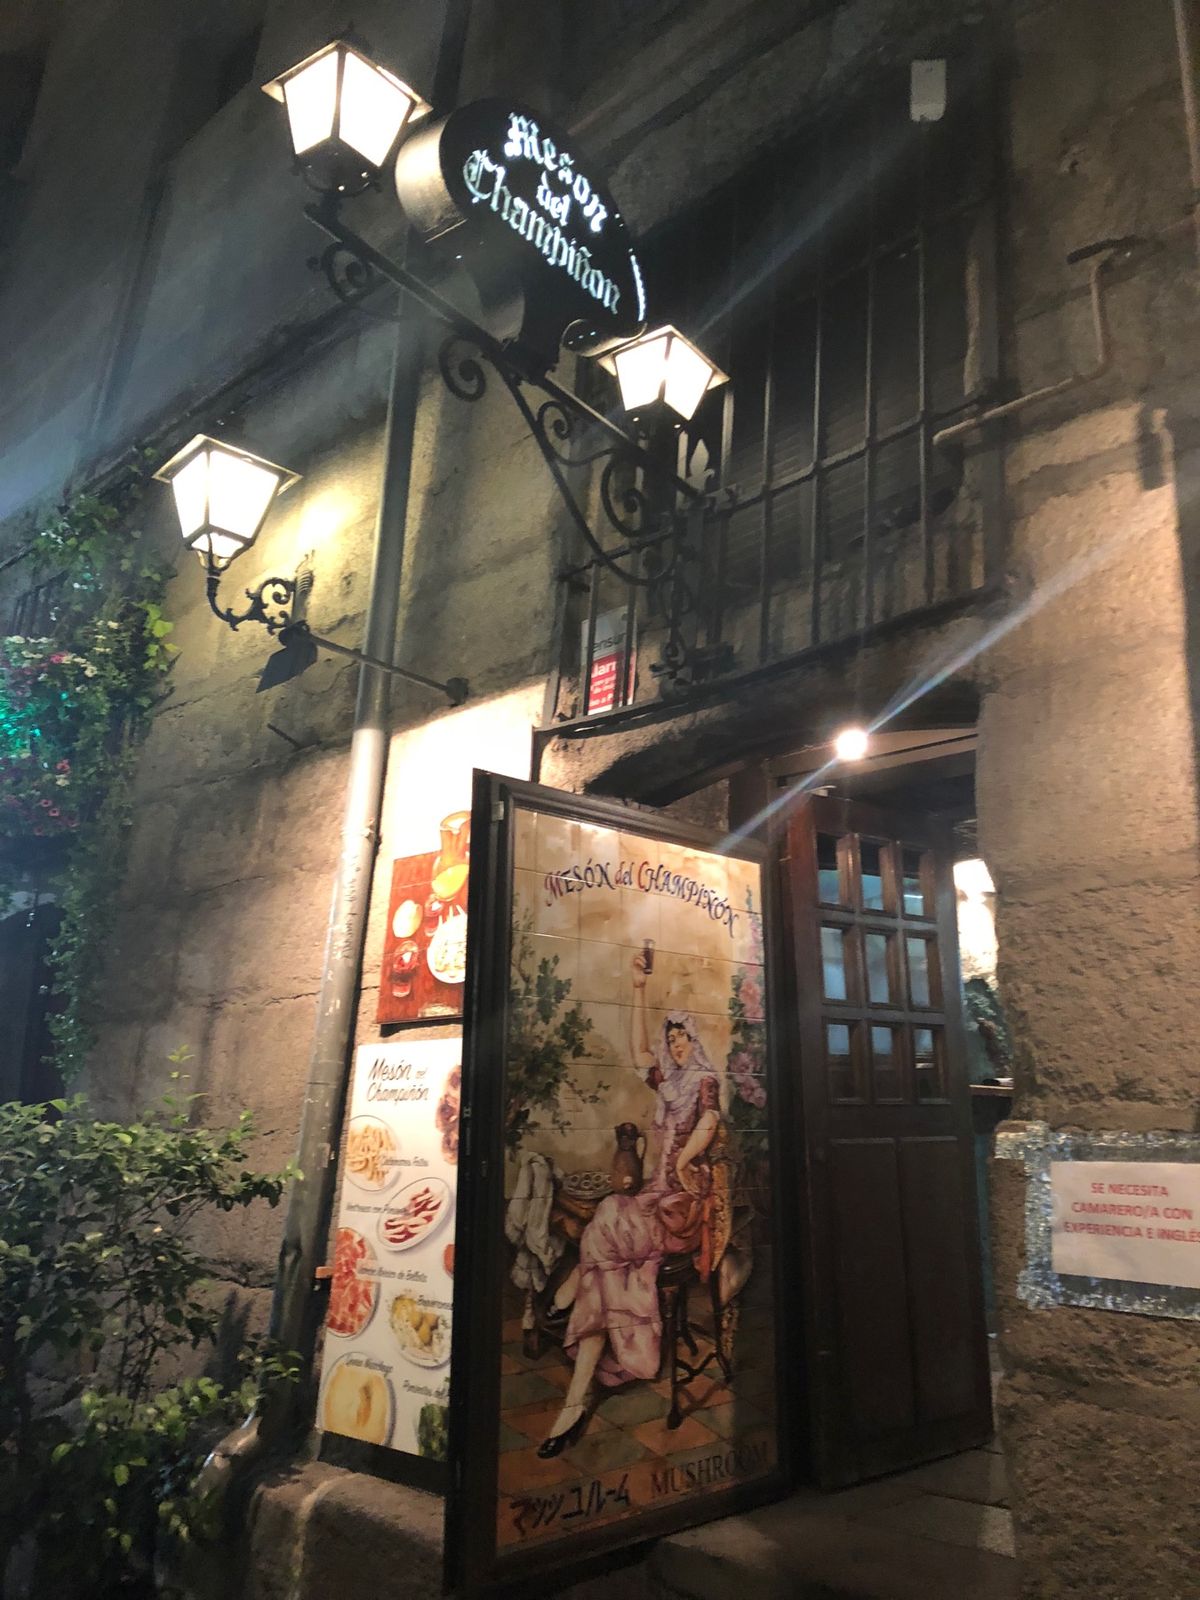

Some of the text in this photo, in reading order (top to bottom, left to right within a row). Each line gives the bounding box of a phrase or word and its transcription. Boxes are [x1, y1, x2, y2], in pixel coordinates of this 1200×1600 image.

[536, 170, 569, 227] del
[544, 858, 739, 938] MESÓN del CHAMPIÑÓN
[369, 1058, 412, 1081] Mesón
[1090, 1182, 1169, 1197] SE NECESITA
[1071, 1202, 1193, 1221] CAMARERO/A CON
[1063, 1221, 1143, 1238] EXPERIENCIA
[1146, 1228, 1155, 1239] E
